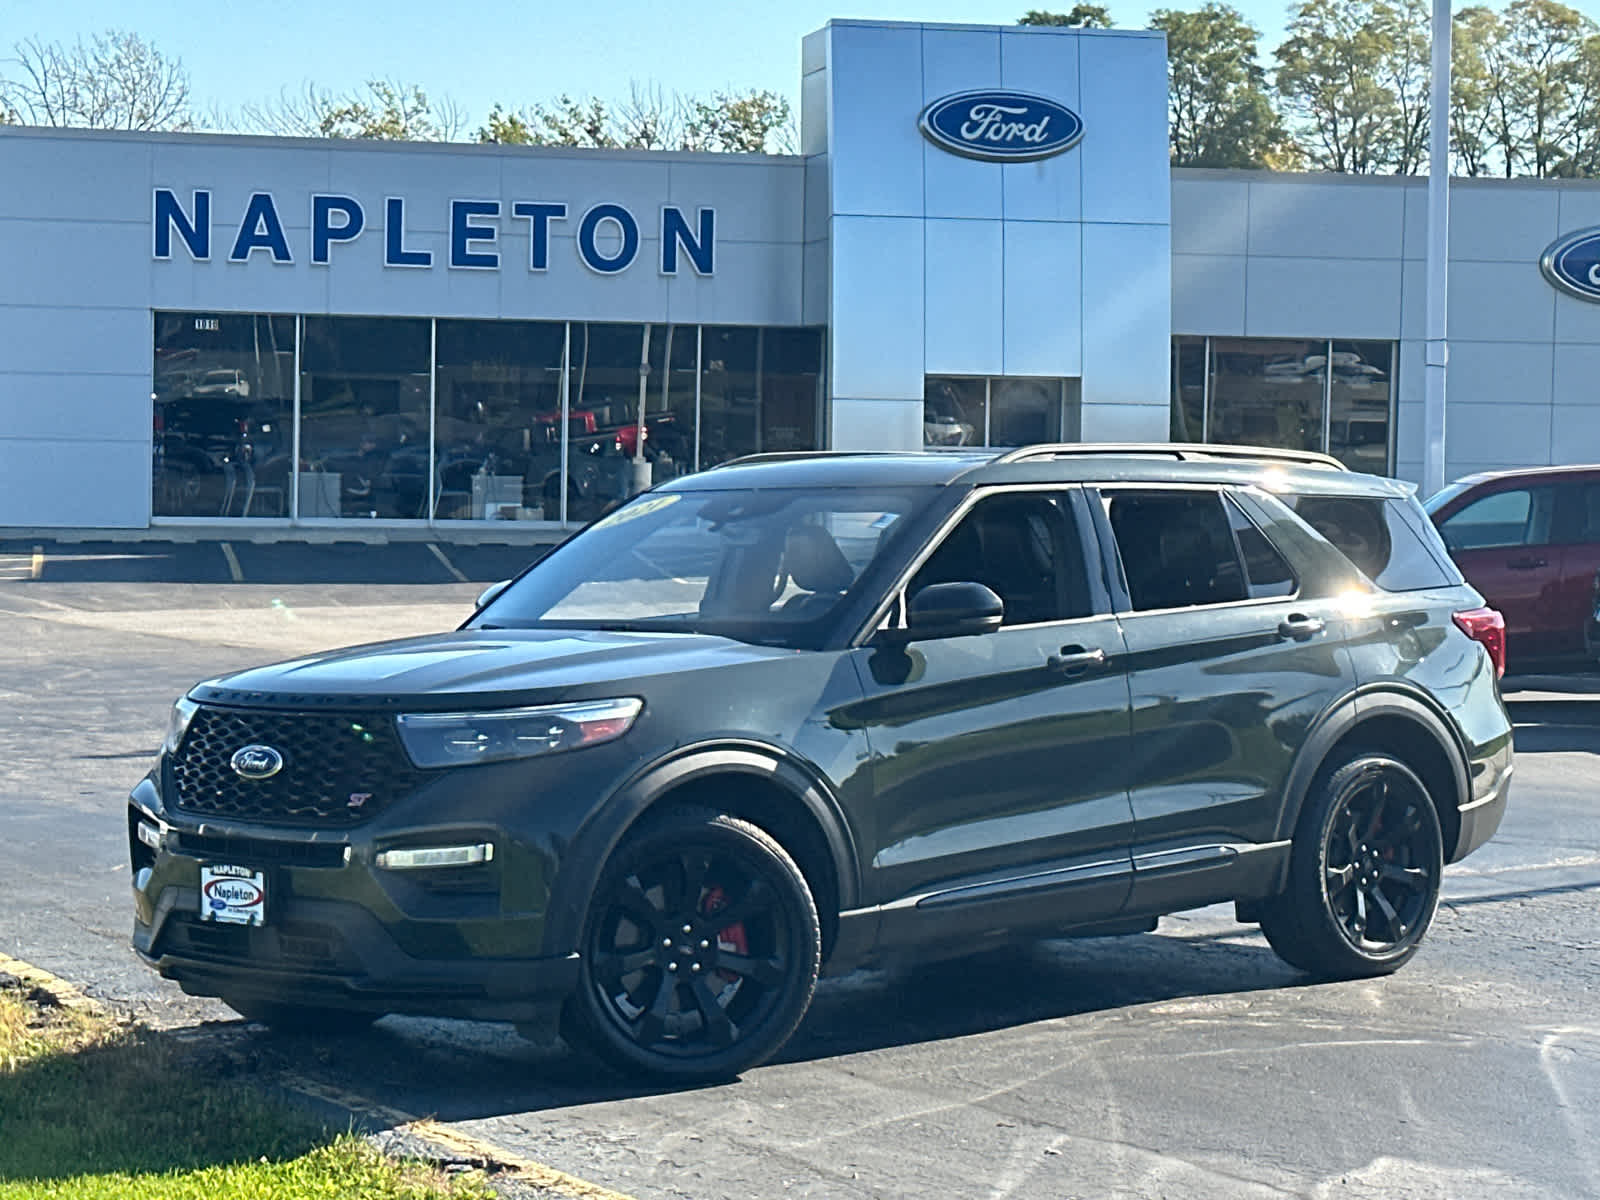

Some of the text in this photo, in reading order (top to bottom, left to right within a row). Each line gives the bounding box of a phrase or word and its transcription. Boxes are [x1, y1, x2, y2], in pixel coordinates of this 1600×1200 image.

[960, 104, 1050, 142] Ford
[152, 187, 716, 276] NAPLETON
[240, 751, 270, 771] Ford
[346, 792, 373, 808] ST
[212, 864, 252, 878] NAPLETON
[214, 883, 254, 901] Napleton
